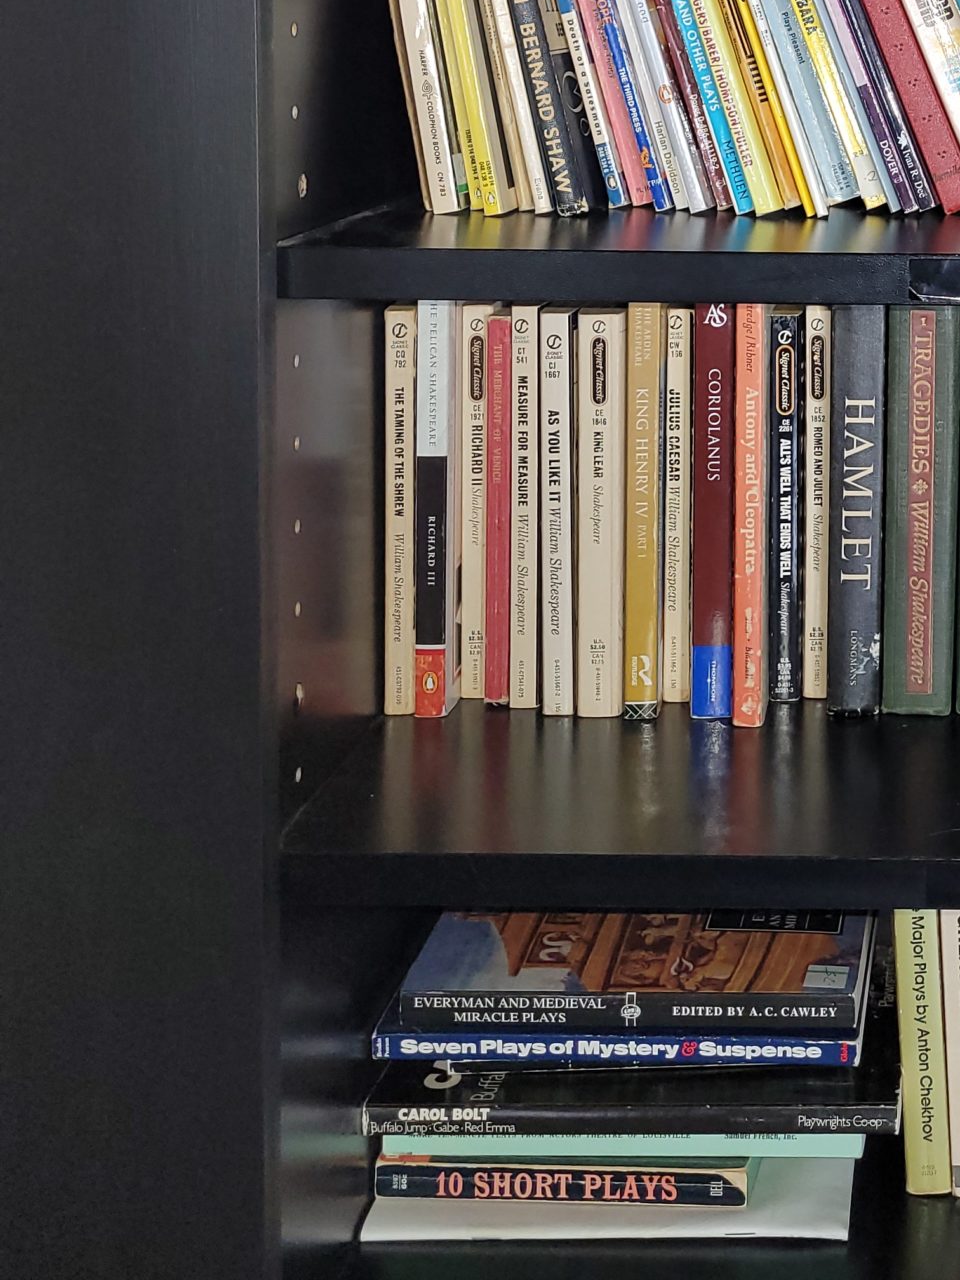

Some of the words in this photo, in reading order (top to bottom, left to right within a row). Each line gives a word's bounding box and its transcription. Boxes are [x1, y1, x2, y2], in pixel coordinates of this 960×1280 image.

[519, 22, 557, 118] BERNARD
[543, 127, 574, 192] SHAW
[394, 387, 404, 406] THE
[518, 376, 529, 426] MEASURE
[668, 389, 680, 431] JULIUS
[913, 331, 932, 472] TRAGEDIES
[394, 408, 404, 445] TAMING
[548, 410, 560, 426] AS
[707, 369, 721, 481] CORIOLANUS
[394, 448, 404, 458] OF
[518, 431, 529, 451] FOR
[548, 430, 560, 454] YOU
[593, 431, 603, 452] KING
[813, 427, 823, 453] ROMEO
[394, 461, 404, 477] THE
[548, 459, 561, 485] LIKE
[593, 455, 603, 478] LEAR
[668, 437, 680, 481] CAESAR
[813, 456, 823, 475] AND
[518, 456, 529, 506] MEASURE
[548, 487, 561, 502] IT
[813, 478, 823, 507] JULIET
[840, 396, 876, 591] HAMLET
[394, 480, 404, 517] SHREW
[394, 533, 405, 574] William
[427, 516, 436, 567] RICHARD
[427, 571, 436, 586] III
[391, 577, 404, 642] Shakespeare
[909, 916, 926, 960] Major
[912, 964, 928, 1001] Plays
[414, 997, 492, 1009] EVERYMAN
[494, 997, 530, 1009] AND
[532, 997, 606, 1009] MEDIEVAL
[914, 1005, 929, 1023] by
[400, 1040, 476, 1056] Seven
[480, 1040, 545, 1058] Plays
[549, 1040, 573, 1056] of
[578, 1041, 678, 1059] Mystery
[682, 1041, 697, 1056] &
[699, 1041, 822, 1060] Suspense
[918, 1029, 931, 1071] Anton
[398, 1108, 449, 1121] CAROL
[453, 1108, 490, 1121] BOLT
[920, 1075, 935, 1142] Chekhov
[436, 1176, 463, 1197] 10
[474, 1173, 572, 1199] SHORT
[585, 1175, 677, 1201] PLAYS
